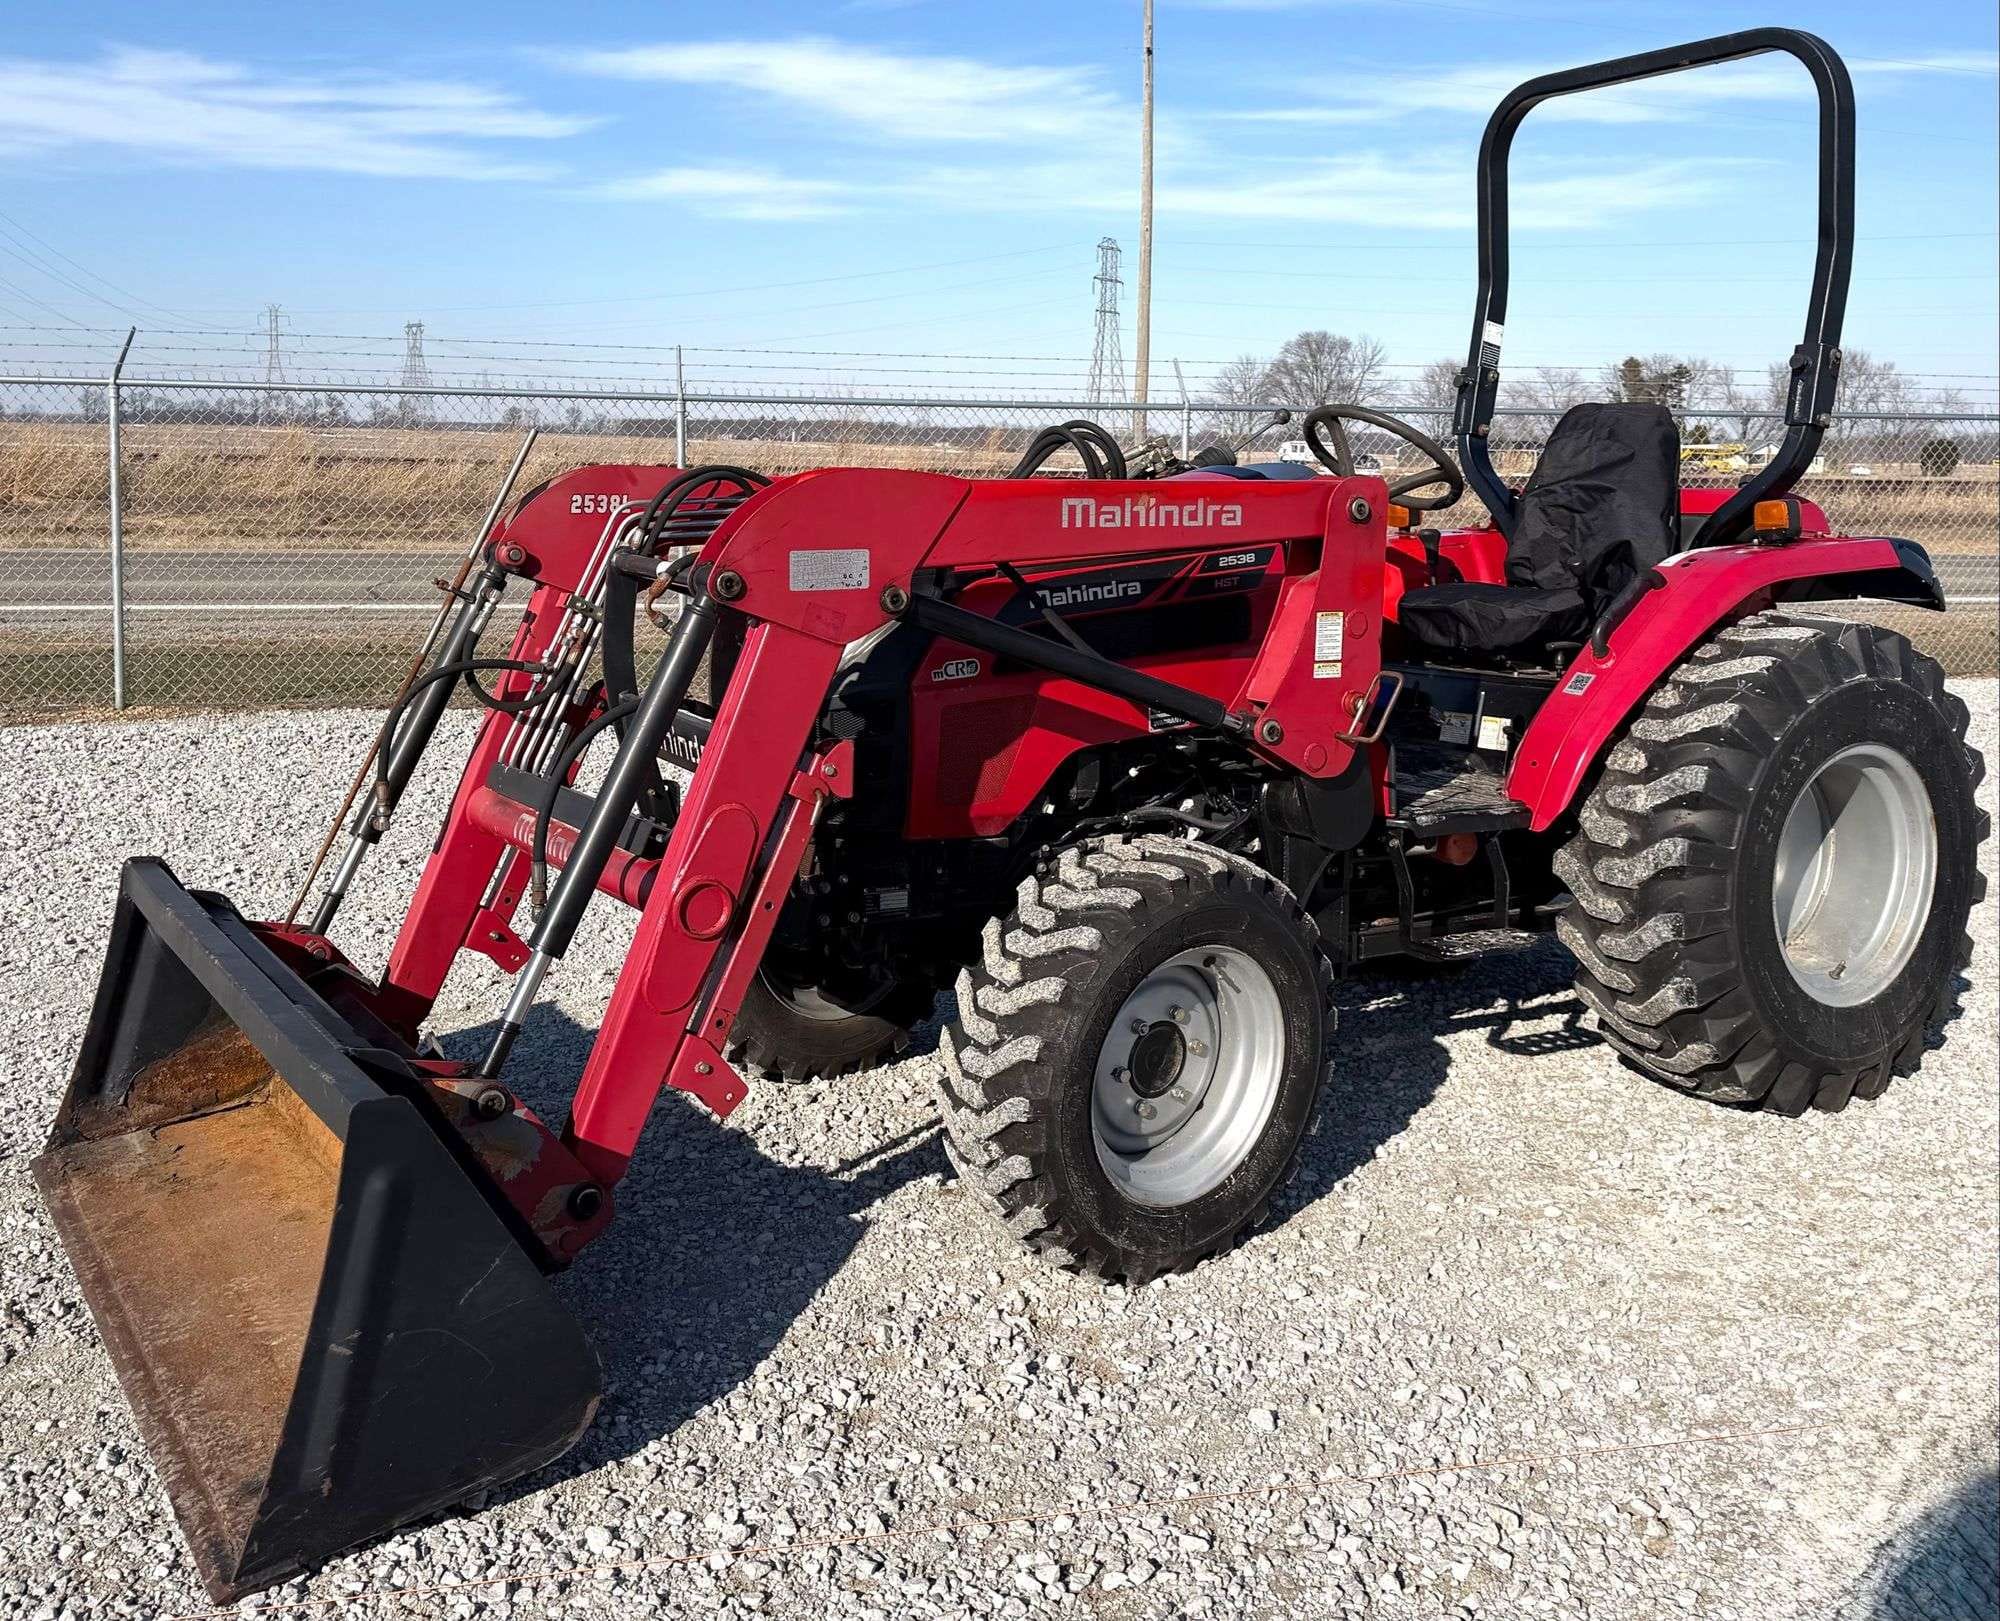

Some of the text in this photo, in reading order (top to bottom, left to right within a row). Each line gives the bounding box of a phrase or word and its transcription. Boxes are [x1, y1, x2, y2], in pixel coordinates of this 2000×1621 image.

[1061, 497, 1242, 528] Mahindra
[1219, 553, 1256, 567] 2538
[1215, 576, 1240, 588] HST
